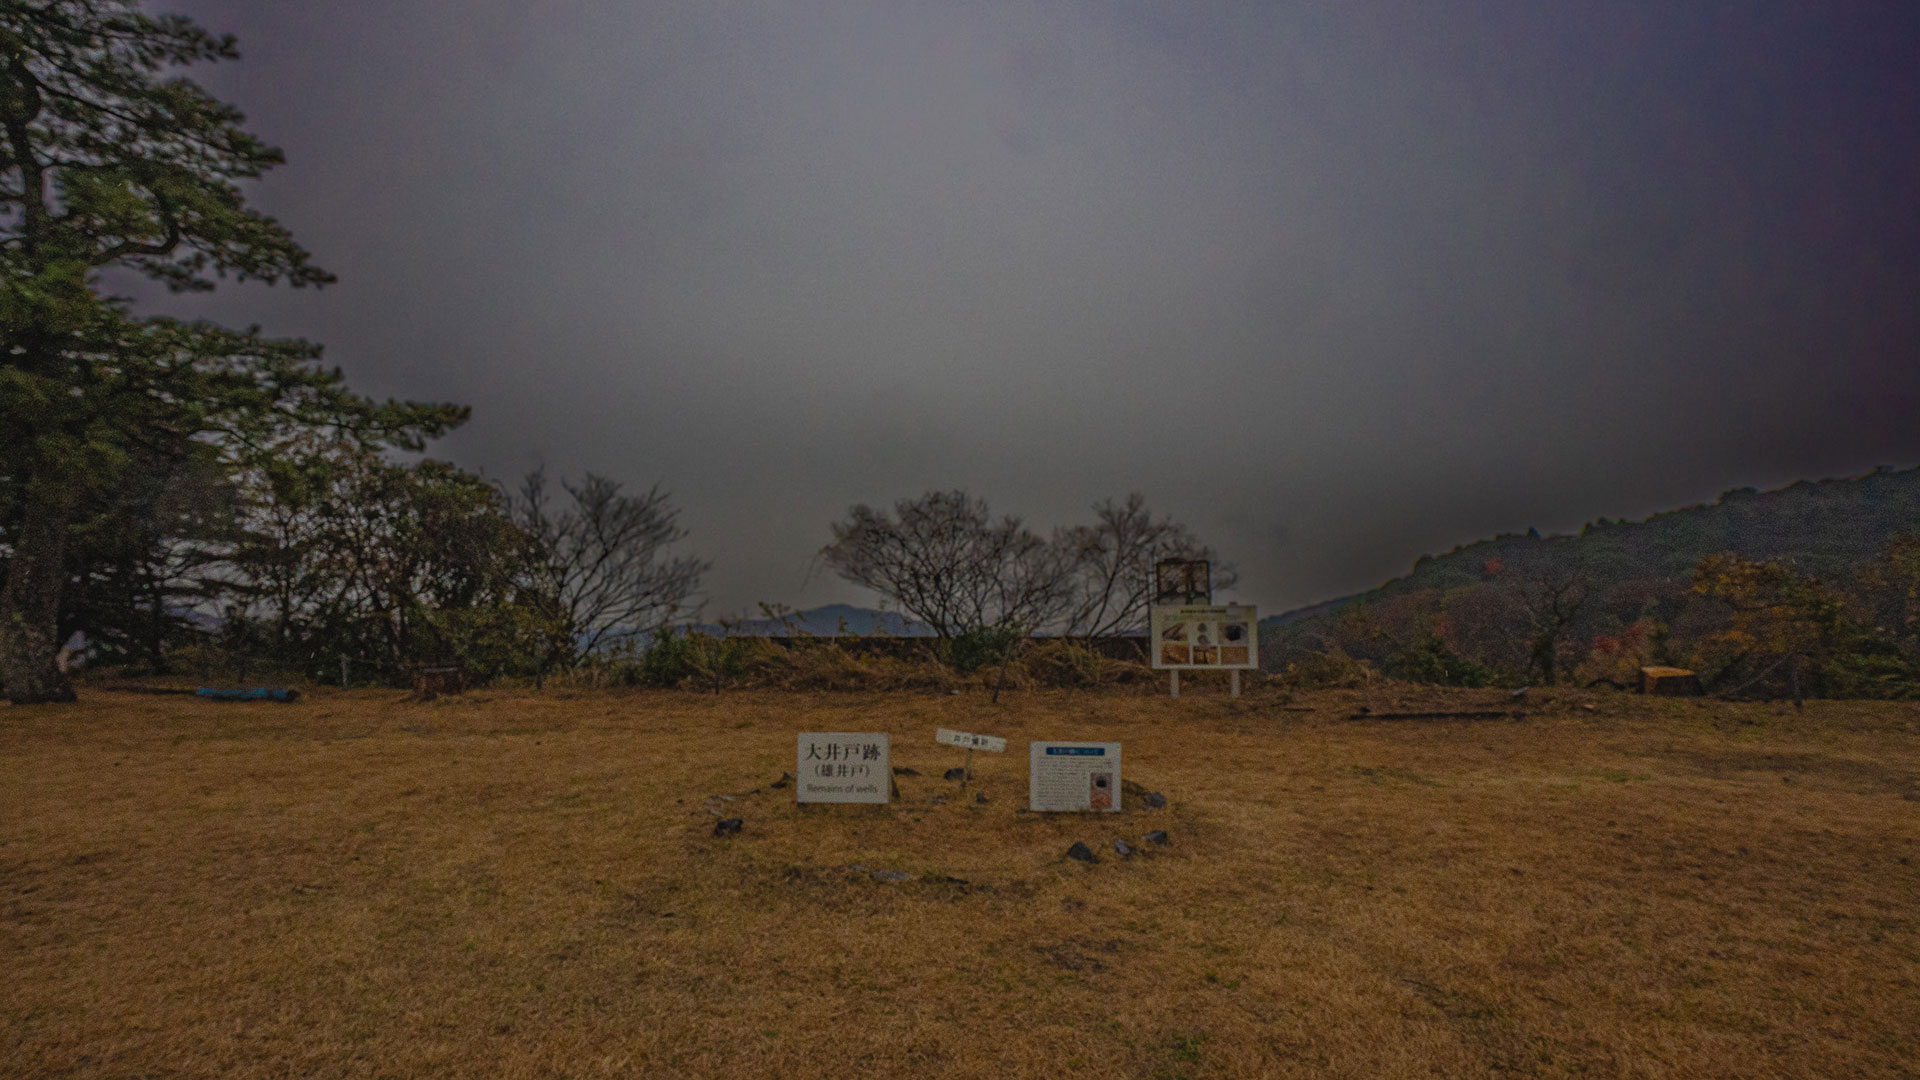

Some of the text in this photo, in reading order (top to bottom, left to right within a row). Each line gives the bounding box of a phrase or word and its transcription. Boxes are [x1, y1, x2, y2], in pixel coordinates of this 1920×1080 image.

[805, 743, 881, 760] 大井戸跡
[807, 784, 877, 793] Remains of wells
